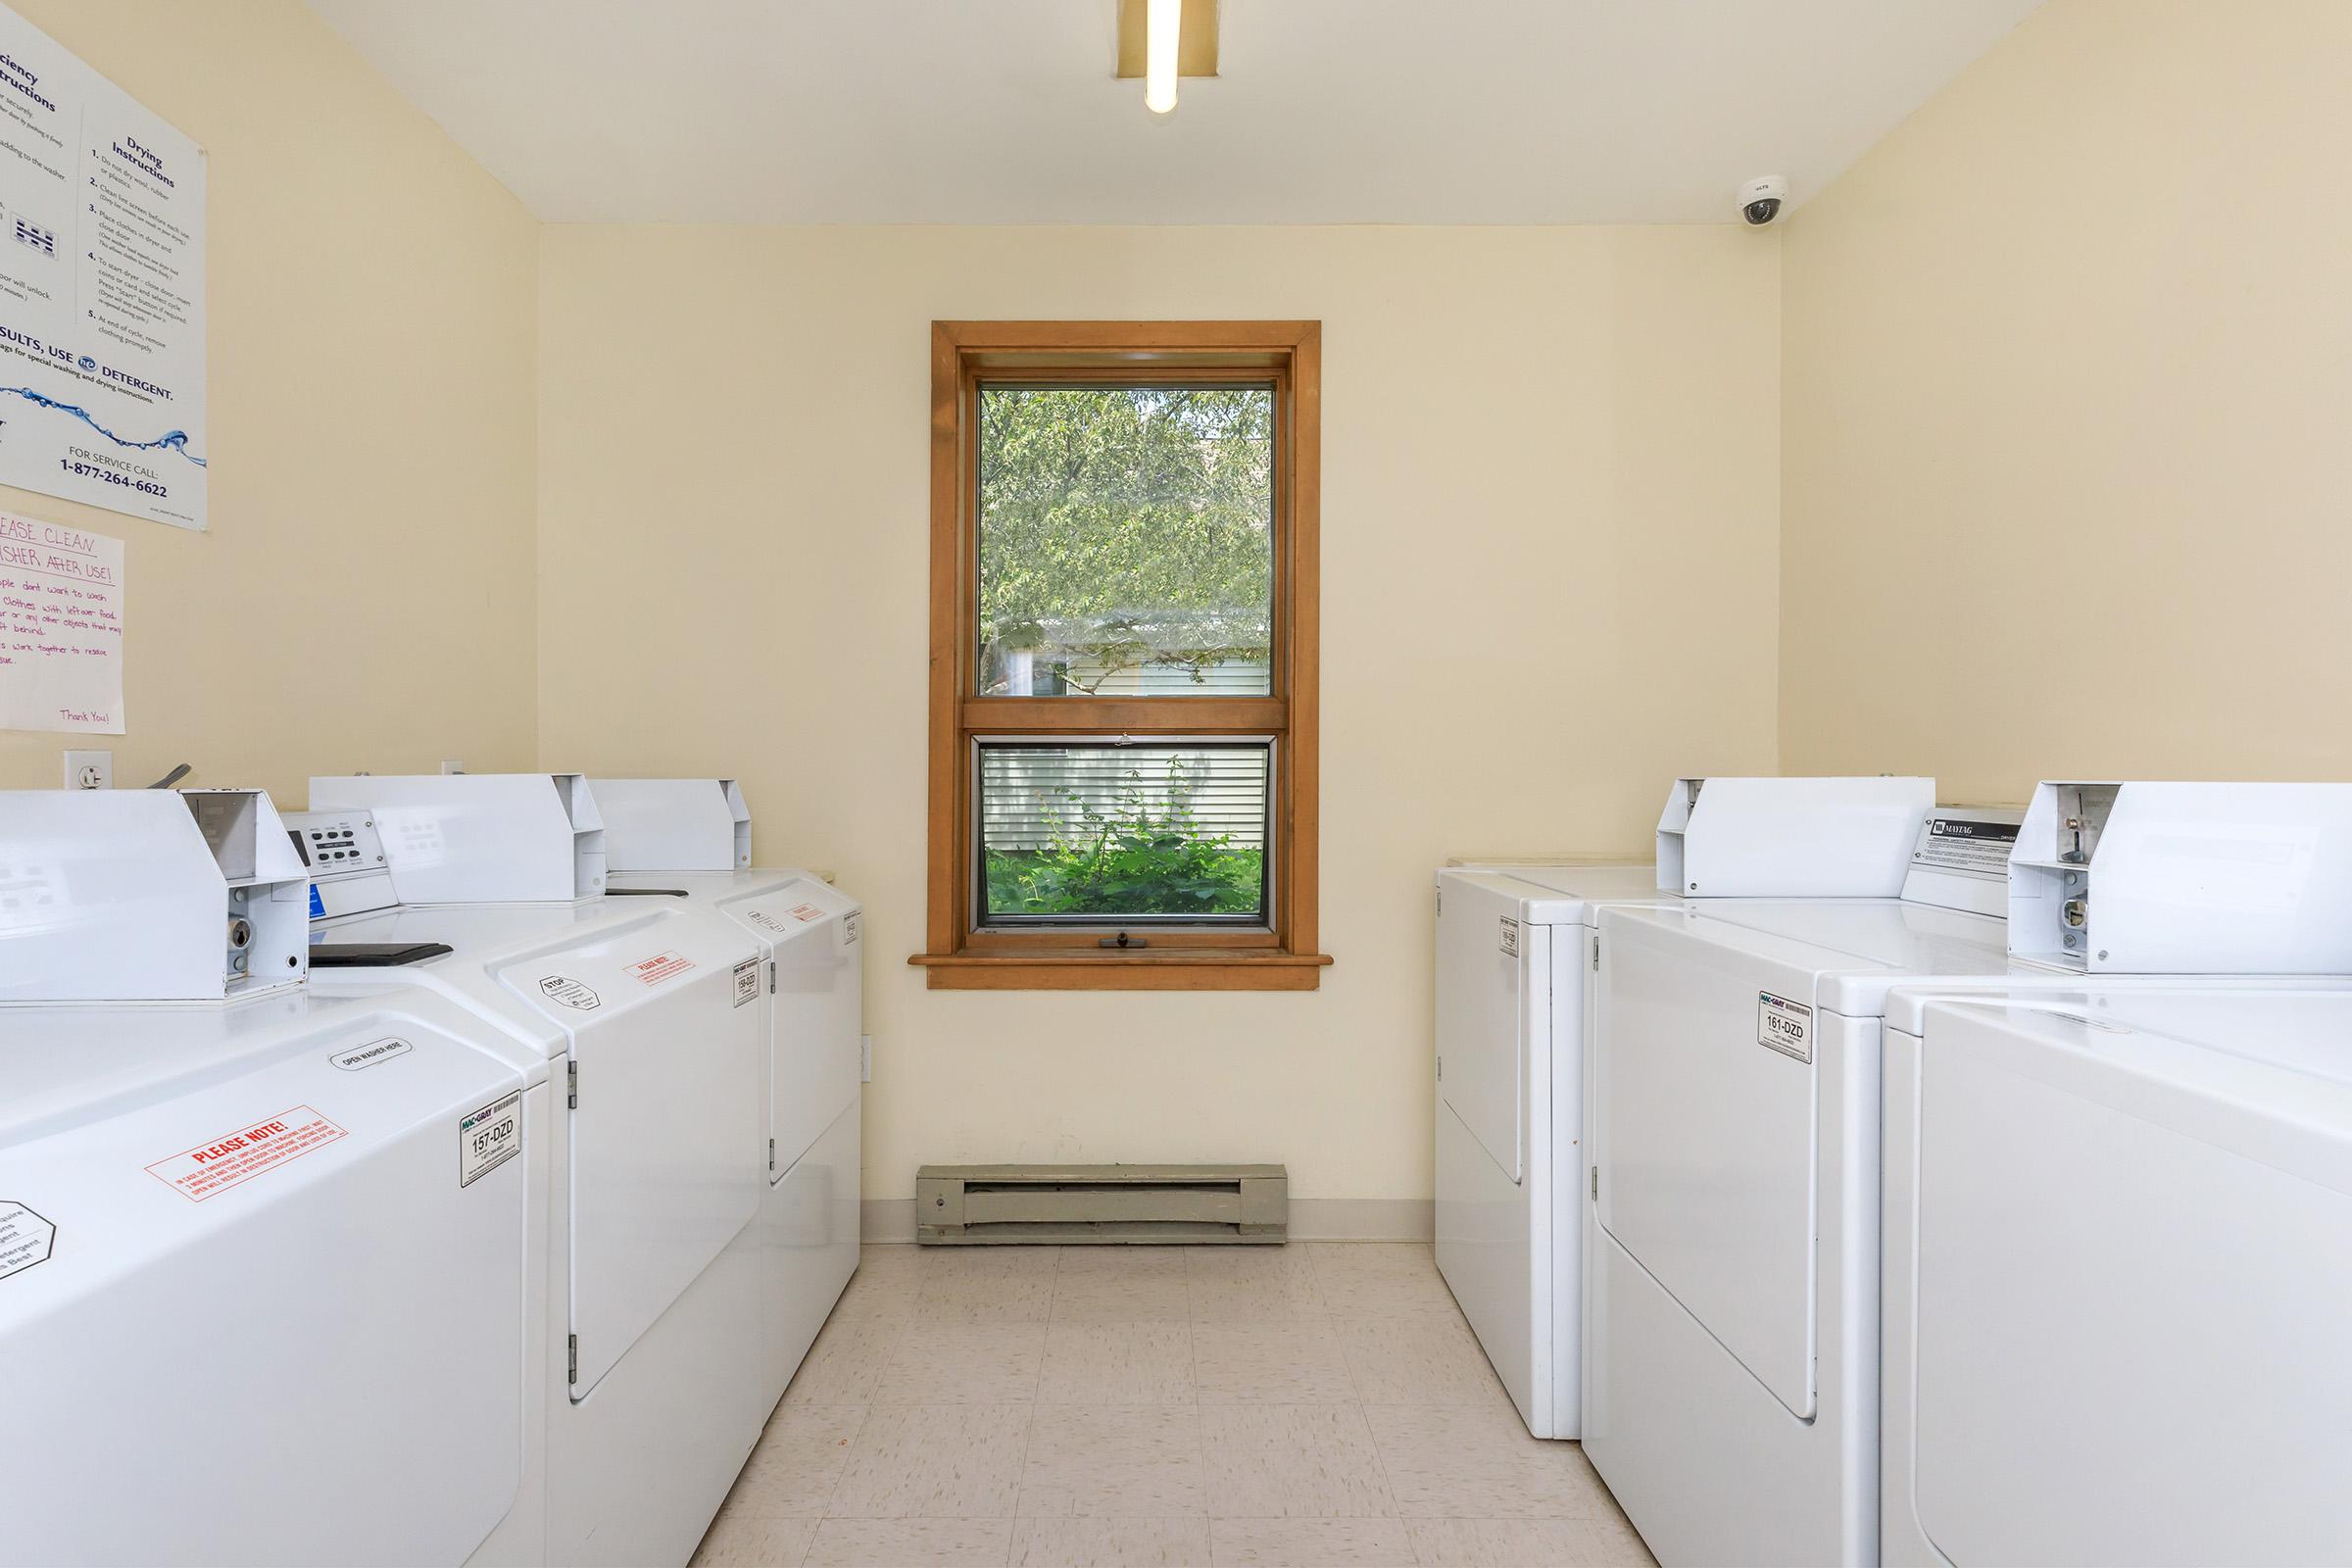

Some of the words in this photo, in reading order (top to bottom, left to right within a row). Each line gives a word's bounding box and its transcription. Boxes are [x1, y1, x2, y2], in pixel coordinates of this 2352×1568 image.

[0, 53, 38, 86] ciency
[24, 153, 31, 162] to
[32, 158, 42, 168] the
[113, 141, 175, 188] Instructions
[127, 135, 163, 171] Drying
[91, 149, 99, 159] 1.
[101, 156, 111, 167] Do
[122, 170, 133, 181] dry
[150, 186, 170, 201] rubber
[89, 176, 98, 188] 2.
[99, 183, 118, 198] Clean
[128, 202, 147, 216] screen
[148, 211, 166, 225] before
[88, 203, 97, 215] 3.
[99, 210, 116, 224] Place
[116, 220, 138, 236] clothes
[145, 236, 161, 247] dryer
[161, 245, 172, 255] and
[98, 221, 115, 234] close
[87, 252, 96, 262] 4.
[98, 257, 108, 267] To
[108, 263, 123, 274] start
[123, 270, 140, 283] dryer
[13, 278, 25, 290] will
[26, 284, 52, 302] unlock.
[98, 270, 116, 282] coins
[123, 281, 138, 292] card
[138, 289, 151, 298] and
[151, 294, 168, 306] select
[98, 278, 115, 292] Press
[137, 296, 158, 311] button
[87, 309, 96, 319] 5.
[107, 319, 120, 329] end
[98, 326, 124, 344] clothing
[0, 325, 45, 354] SULTS,
[48, 345, 74, 364] USE
[102, 366, 173, 402] DETERGENT.
[15, 347, 25, 357] for
[27, 353, 52, 367] special
[52, 363, 81, 379] washing
[81, 374, 95, 383] and
[95, 378, 117, 392] drying
[117, 385, 155, 405] instructions.
[69, 446, 91, 461] FOR
[93, 453, 132, 473] SERVICE
[133, 465, 160, 480] CALL:
[60, 458, 169, 498] 1-877-264-6622
[44, 527, 95, 553] CLEAN
[46, 555, 82, 576] AFTER
[85, 564, 113, 584] USE!
[42, 604, 62, 614] with
[72, 589, 83, 598] to
[86, 591, 108, 603] wash
[24, 614, 38, 626] any
[41, 615, 60, 624] other
[63, 619, 89, 629] objects
[37, 644, 68, 657] together
[71, 645, 80, 655] to
[59, 710, 89, 723] Thank
[90, 711, 111, 725] You!
[1943, 823, 1973, 835] MAYTAG
[543, 978, 564, 989] STOP
[1767, 1014, 1804, 1039] 161-DZD
[342, 1055, 363, 1066] OPEN
[359, 1046, 388, 1060] WASHER
[384, 1041, 404, 1052] HERE
[462, 1106, 493, 1131] MAC-GRAY
[191, 1136, 250, 1164] PLEASE
[244, 1120, 289, 1144] NOTE!
[471, 1119, 514, 1153] 157-DZD
[182, 1171, 200, 1184] CASE
[189, 1172, 216, 1189] MINUTES
[215, 1167, 228, 1177] AND
[226, 1160, 243, 1173] THEN
[240, 1154, 255, 1167] OPEN
[191, 1185, 209, 1196] OPEN
[207, 1179, 222, 1191] WILL
[220, 1171, 243, 1188] RESULT
[246, 1153, 278, 1173] DESTRUCTION
[7, 1252, 33, 1266] Best
